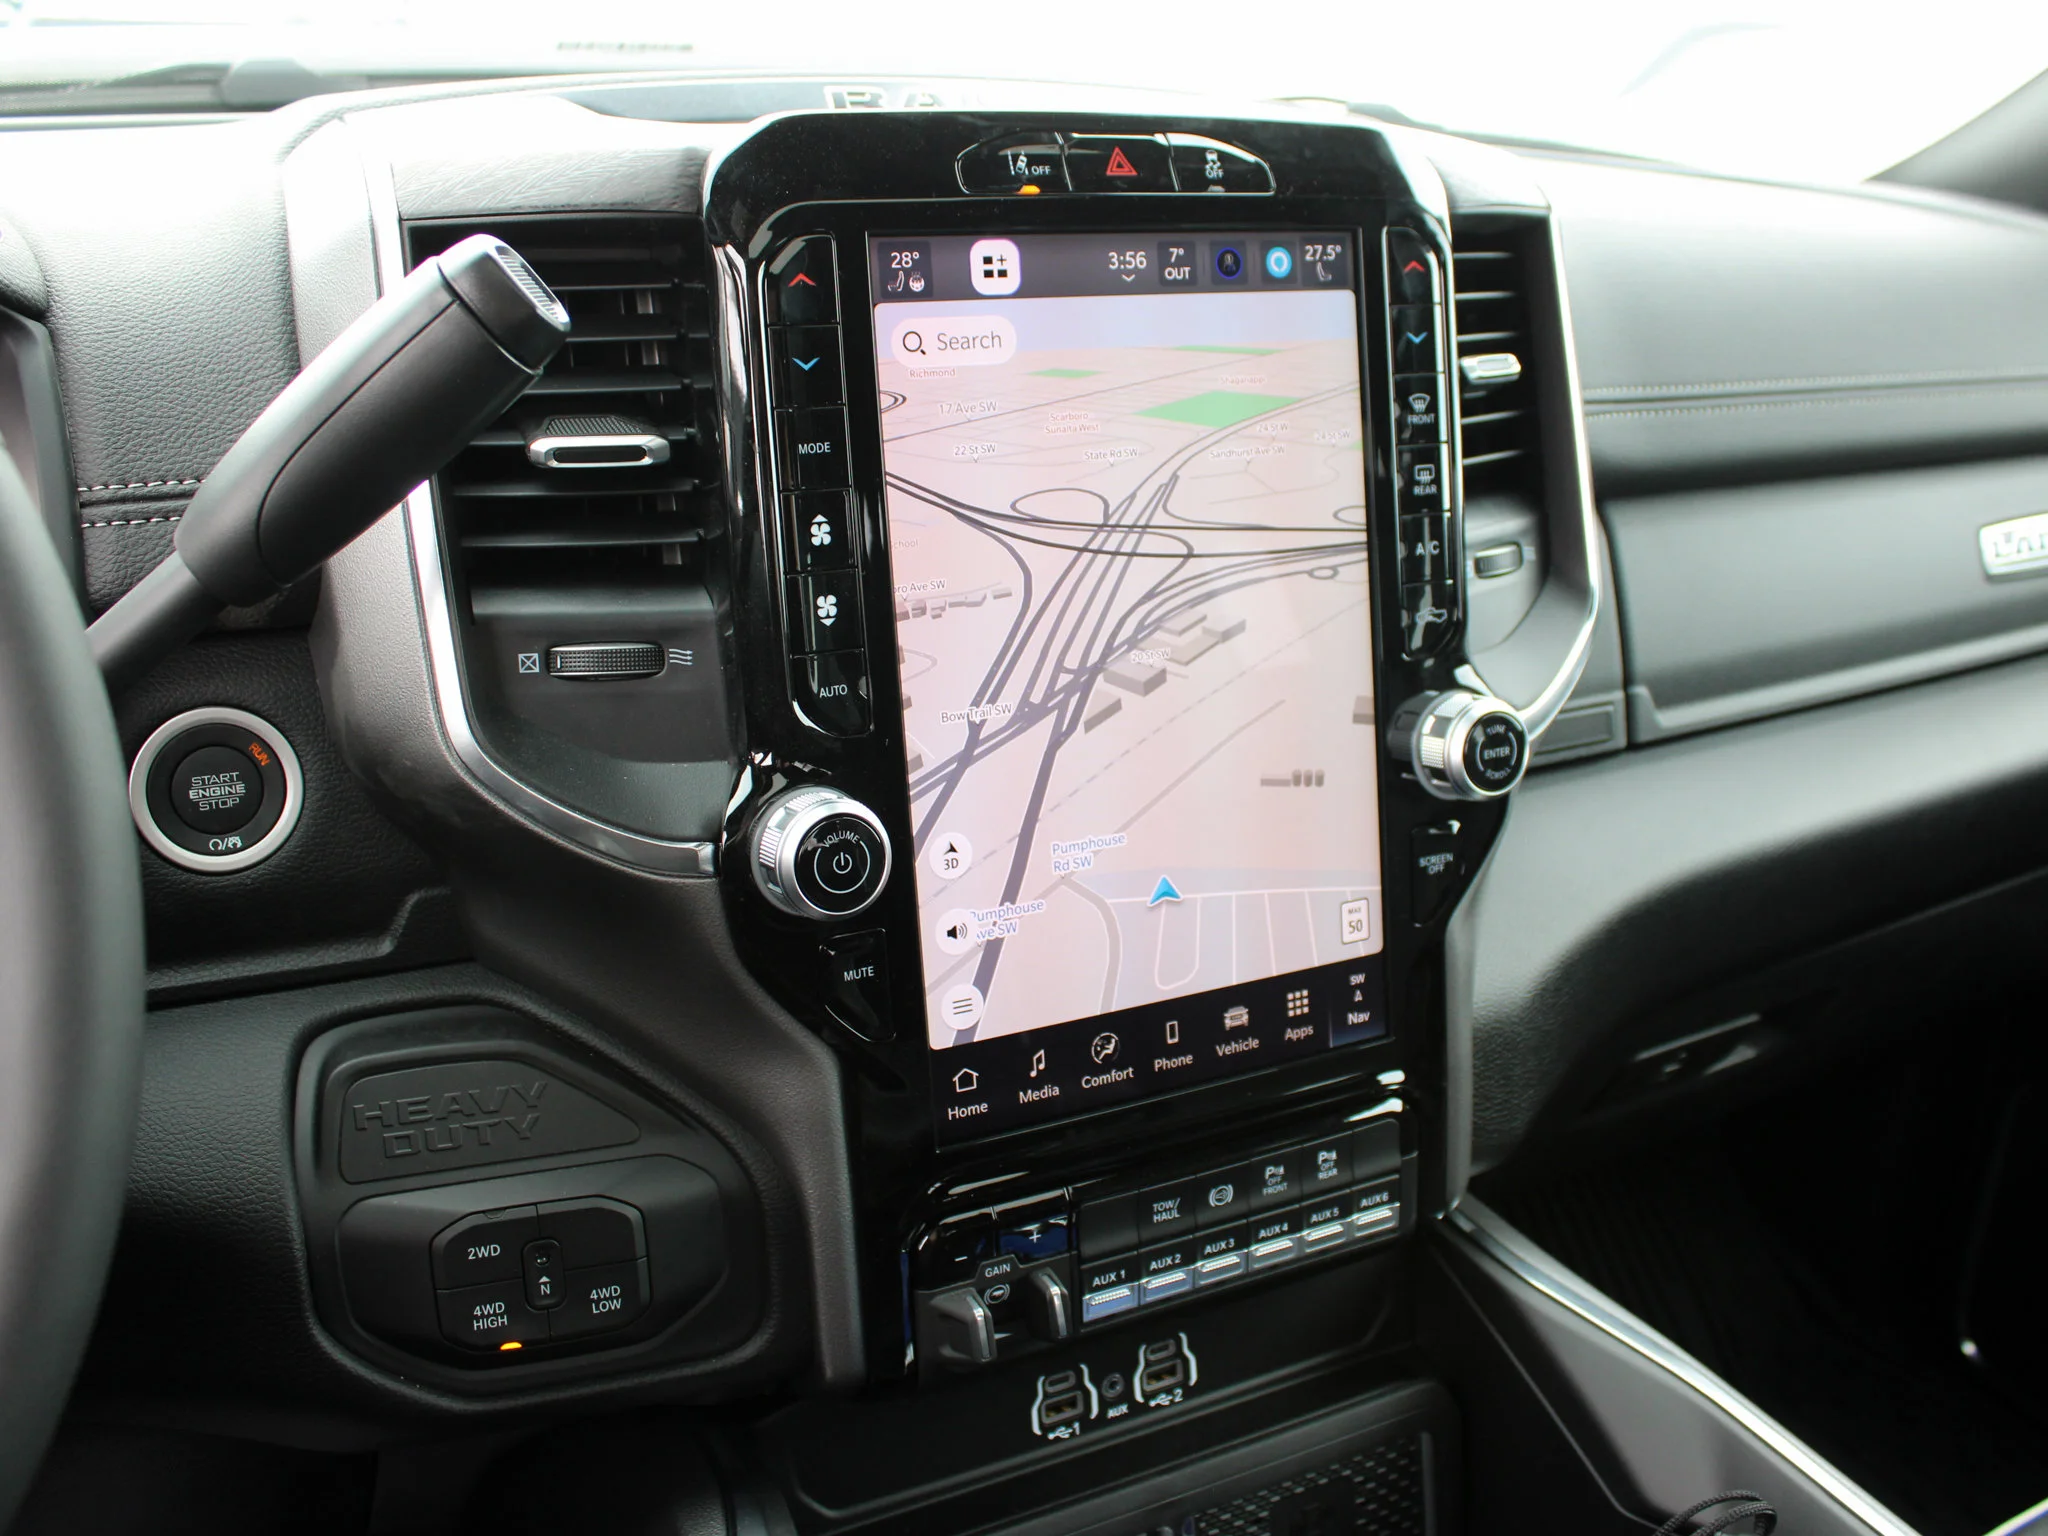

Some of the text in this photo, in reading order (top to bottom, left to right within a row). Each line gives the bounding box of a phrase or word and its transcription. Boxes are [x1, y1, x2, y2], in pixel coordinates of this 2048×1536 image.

[1031, 165, 1052, 176] OFF
[1205, 168, 1224, 179] OFF
[891, 252, 920, 268] 28°
[1108, 251, 1148, 270] 3:56
[1169, 247, 1185, 263] 7°
[1305, 245, 1342, 261] 27.5°
[1164, 266, 1191, 280] OUT
[936, 331, 1002, 351] Search
[909, 368, 956, 379] Richmond
[940, 401, 997, 414] 17 Ave SW
[1050, 412, 1089, 422] Scarboro
[1407, 413, 1435, 424] FRONT
[1079, 423, 1099, 433] West
[799, 442, 831, 455] MODE
[955, 444, 996, 456] 22 St SW
[1084, 448, 1138, 460] State Rd SW
[1413, 484, 1437, 496] REAR
[910, 582, 928, 592] Ave
[930, 580, 945, 589] SW
[1155, 649, 1170, 659] SW
[819, 684, 848, 698] AUTO
[941, 703, 1012, 723] Bow Trail SW
[1486, 724, 1507, 736] TUNE
[249, 742, 271, 766] RUN
[1484, 746, 1511, 759] ENTER
[192, 771, 240, 786] START
[189, 784, 246, 799] ENGINE
[199, 797, 240, 811] STOP
[823, 830, 861, 848] VOLUME
[1052, 833, 1126, 855] Pumphouse
[943, 858, 959, 870] 3D
[1053, 855, 1092, 873] Rd SW
[1418, 853, 1453, 867] SCREEN
[1428, 864, 1445, 875] OFF
[998, 921, 1018, 936] SW
[1348, 919, 1363, 934] 50
[844, 966, 875, 982] MUTE
[1350, 973, 1365, 985] SW
[1347, 1011, 1370, 1025] Nav
[1285, 1025, 1314, 1042] Apps
[1216, 1036, 1260, 1057] Vehicle
[1154, 1053, 1193, 1072] Phone
[1081, 1067, 1135, 1089] Comfort
[1019, 1084, 1060, 1104] Media
[353, 1081, 547, 1131] HEAVY
[948, 1103, 989, 1120] Home
[383, 1112, 542, 1158] DUTY
[1320, 1161, 1335, 1171] OFF
[1267, 1176, 1282, 1186] OFF
[1318, 1168, 1338, 1180] REAR
[1263, 1182, 1288, 1196] FRONT
[1152, 1197, 1181, 1212] TOW/
[1360, 1191, 1389, 1208] AUX 6
[1153, 1208, 1181, 1223] HAUL
[1310, 1207, 1340, 1224] AUX 5
[1258, 1222, 1289, 1239] AUX 4
[467, 1244, 501, 1260] 2WD
[1203, 1238, 1235, 1255] AUX 3
[1150, 1253, 1181, 1271] AUX 2
[985, 1263, 1011, 1278] GAIN
[1092, 1269, 1126, 1287] AUX 1
[540, 1284, 551, 1296] N
[590, 1285, 621, 1300] 4WD
[473, 1302, 505, 1317] 4WD
[592, 1298, 622, 1314] LOW
[473, 1315, 508, 1331] HIGH
[1173, 1389, 1183, 1403] 2
[1107, 1404, 1129, 1419] AUX
[1073, 1421, 1080, 1436] 1
